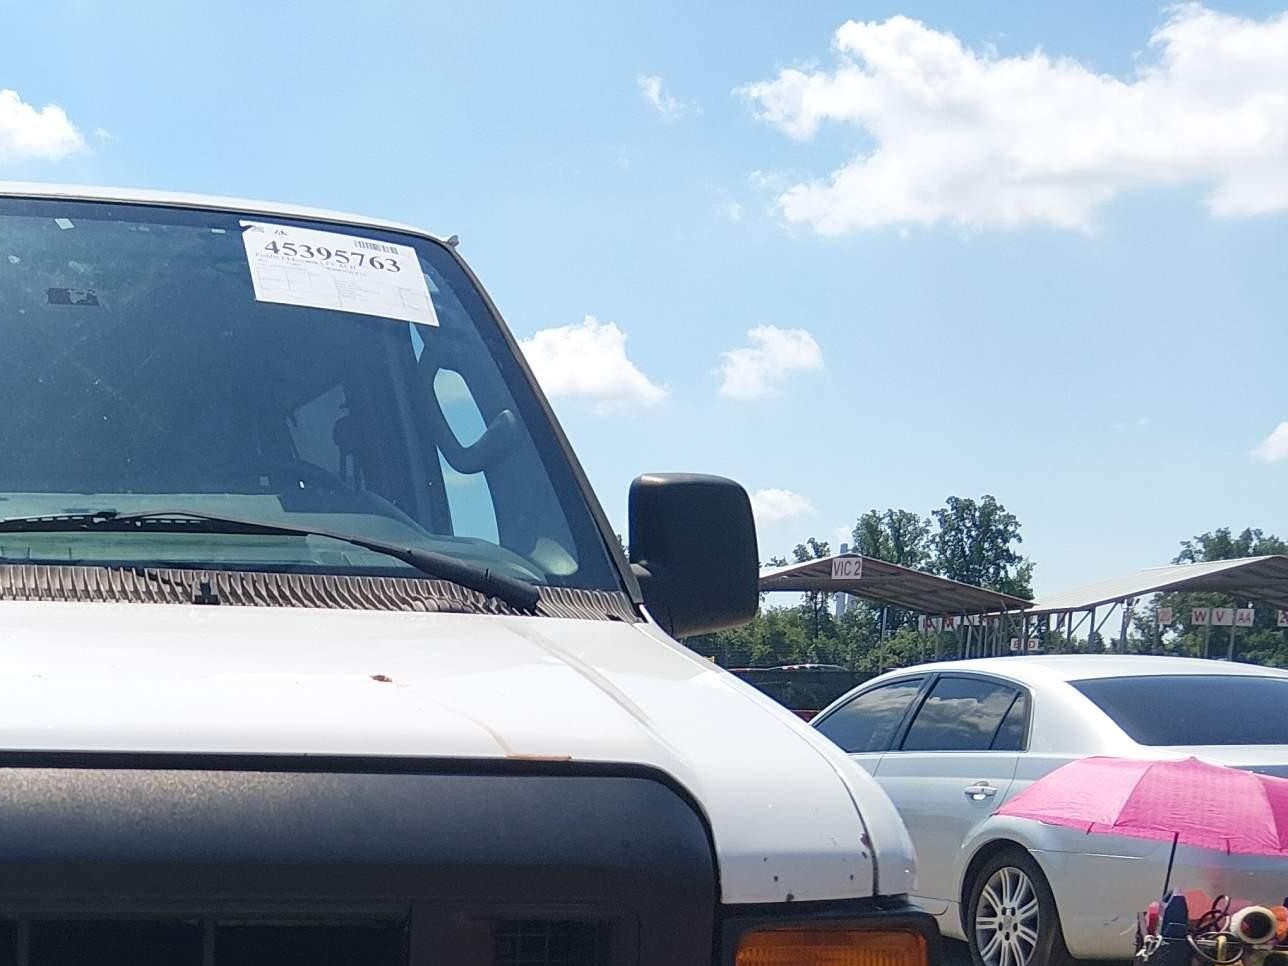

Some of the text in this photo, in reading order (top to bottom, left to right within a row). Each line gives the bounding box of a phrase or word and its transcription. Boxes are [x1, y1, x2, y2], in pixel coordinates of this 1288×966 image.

[264, 240, 401, 273] 45395763
[833, 560, 861, 577] VIC 2
[1193, 610, 1207, 622] W
[1215, 610, 1225, 622] V
